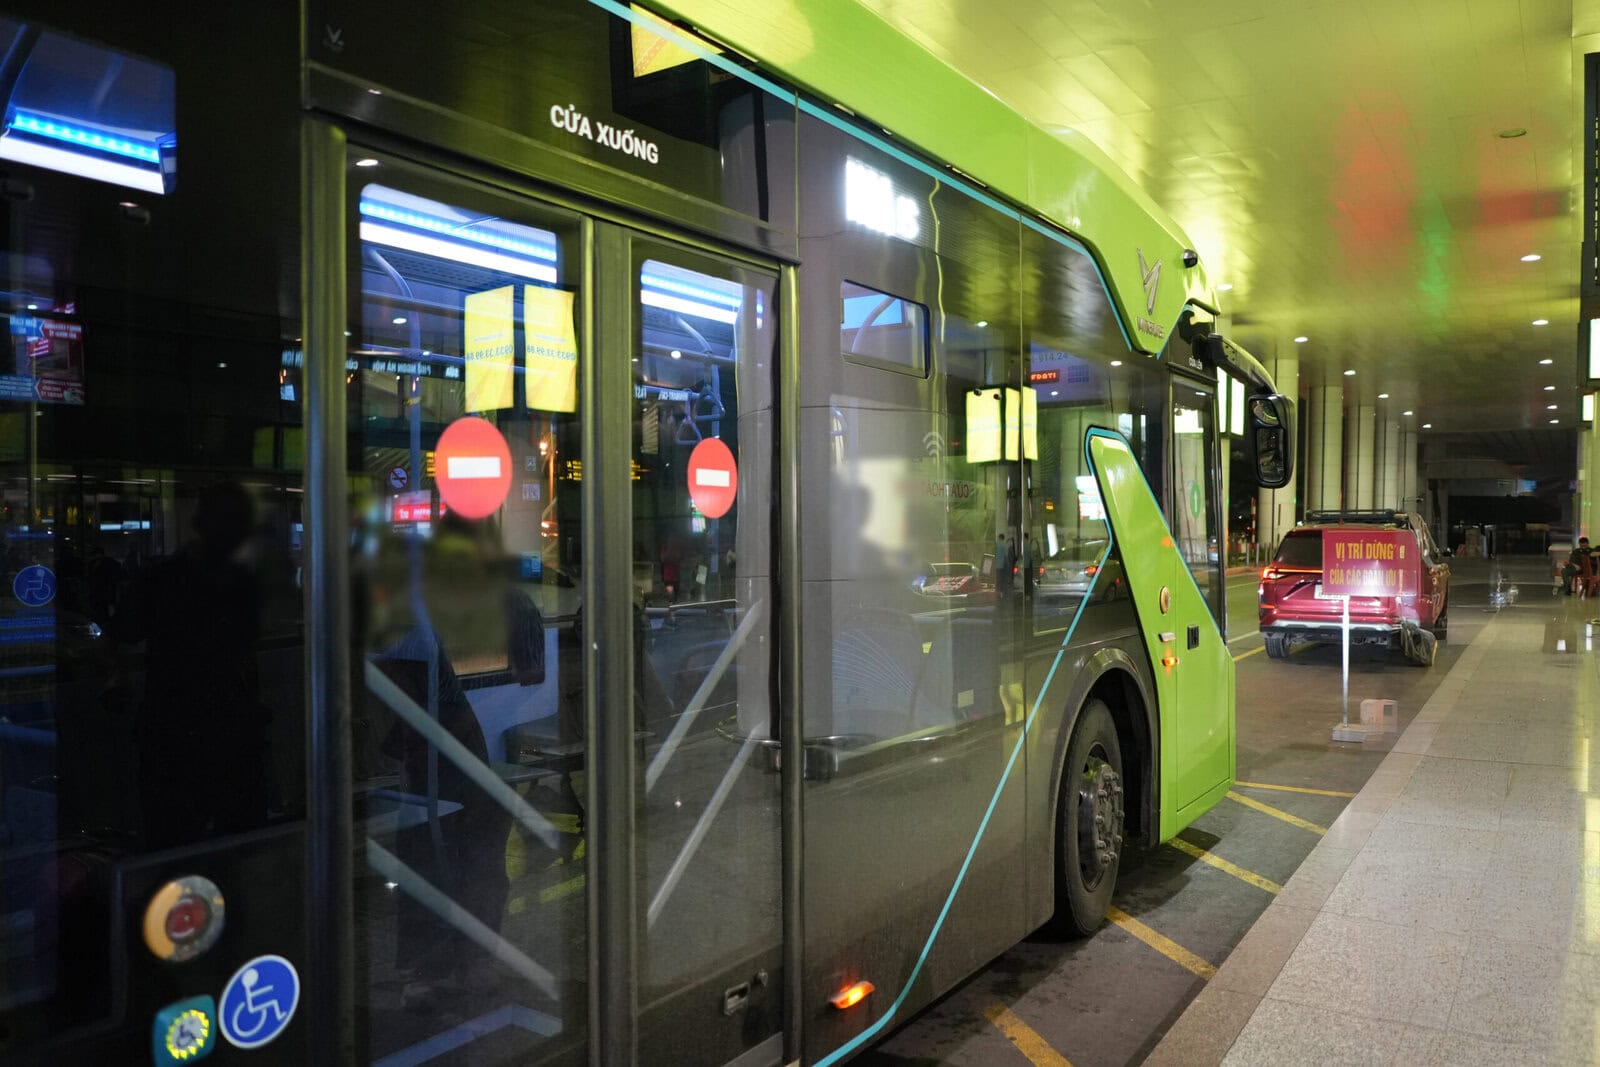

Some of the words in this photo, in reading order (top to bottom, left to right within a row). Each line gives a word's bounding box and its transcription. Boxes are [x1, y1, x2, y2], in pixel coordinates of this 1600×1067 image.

[550, 104, 593, 140] CỬA
[596, 121, 659, 164] XUỐNG
[1336, 542, 1345, 561] VỊ
[1348, 539, 1363, 560] TRÍ
[1366, 539, 1394, 560] DỪNG
[1329, 563, 1345, 585] CỦA
[1346, 566, 1362, 585] CÁC
